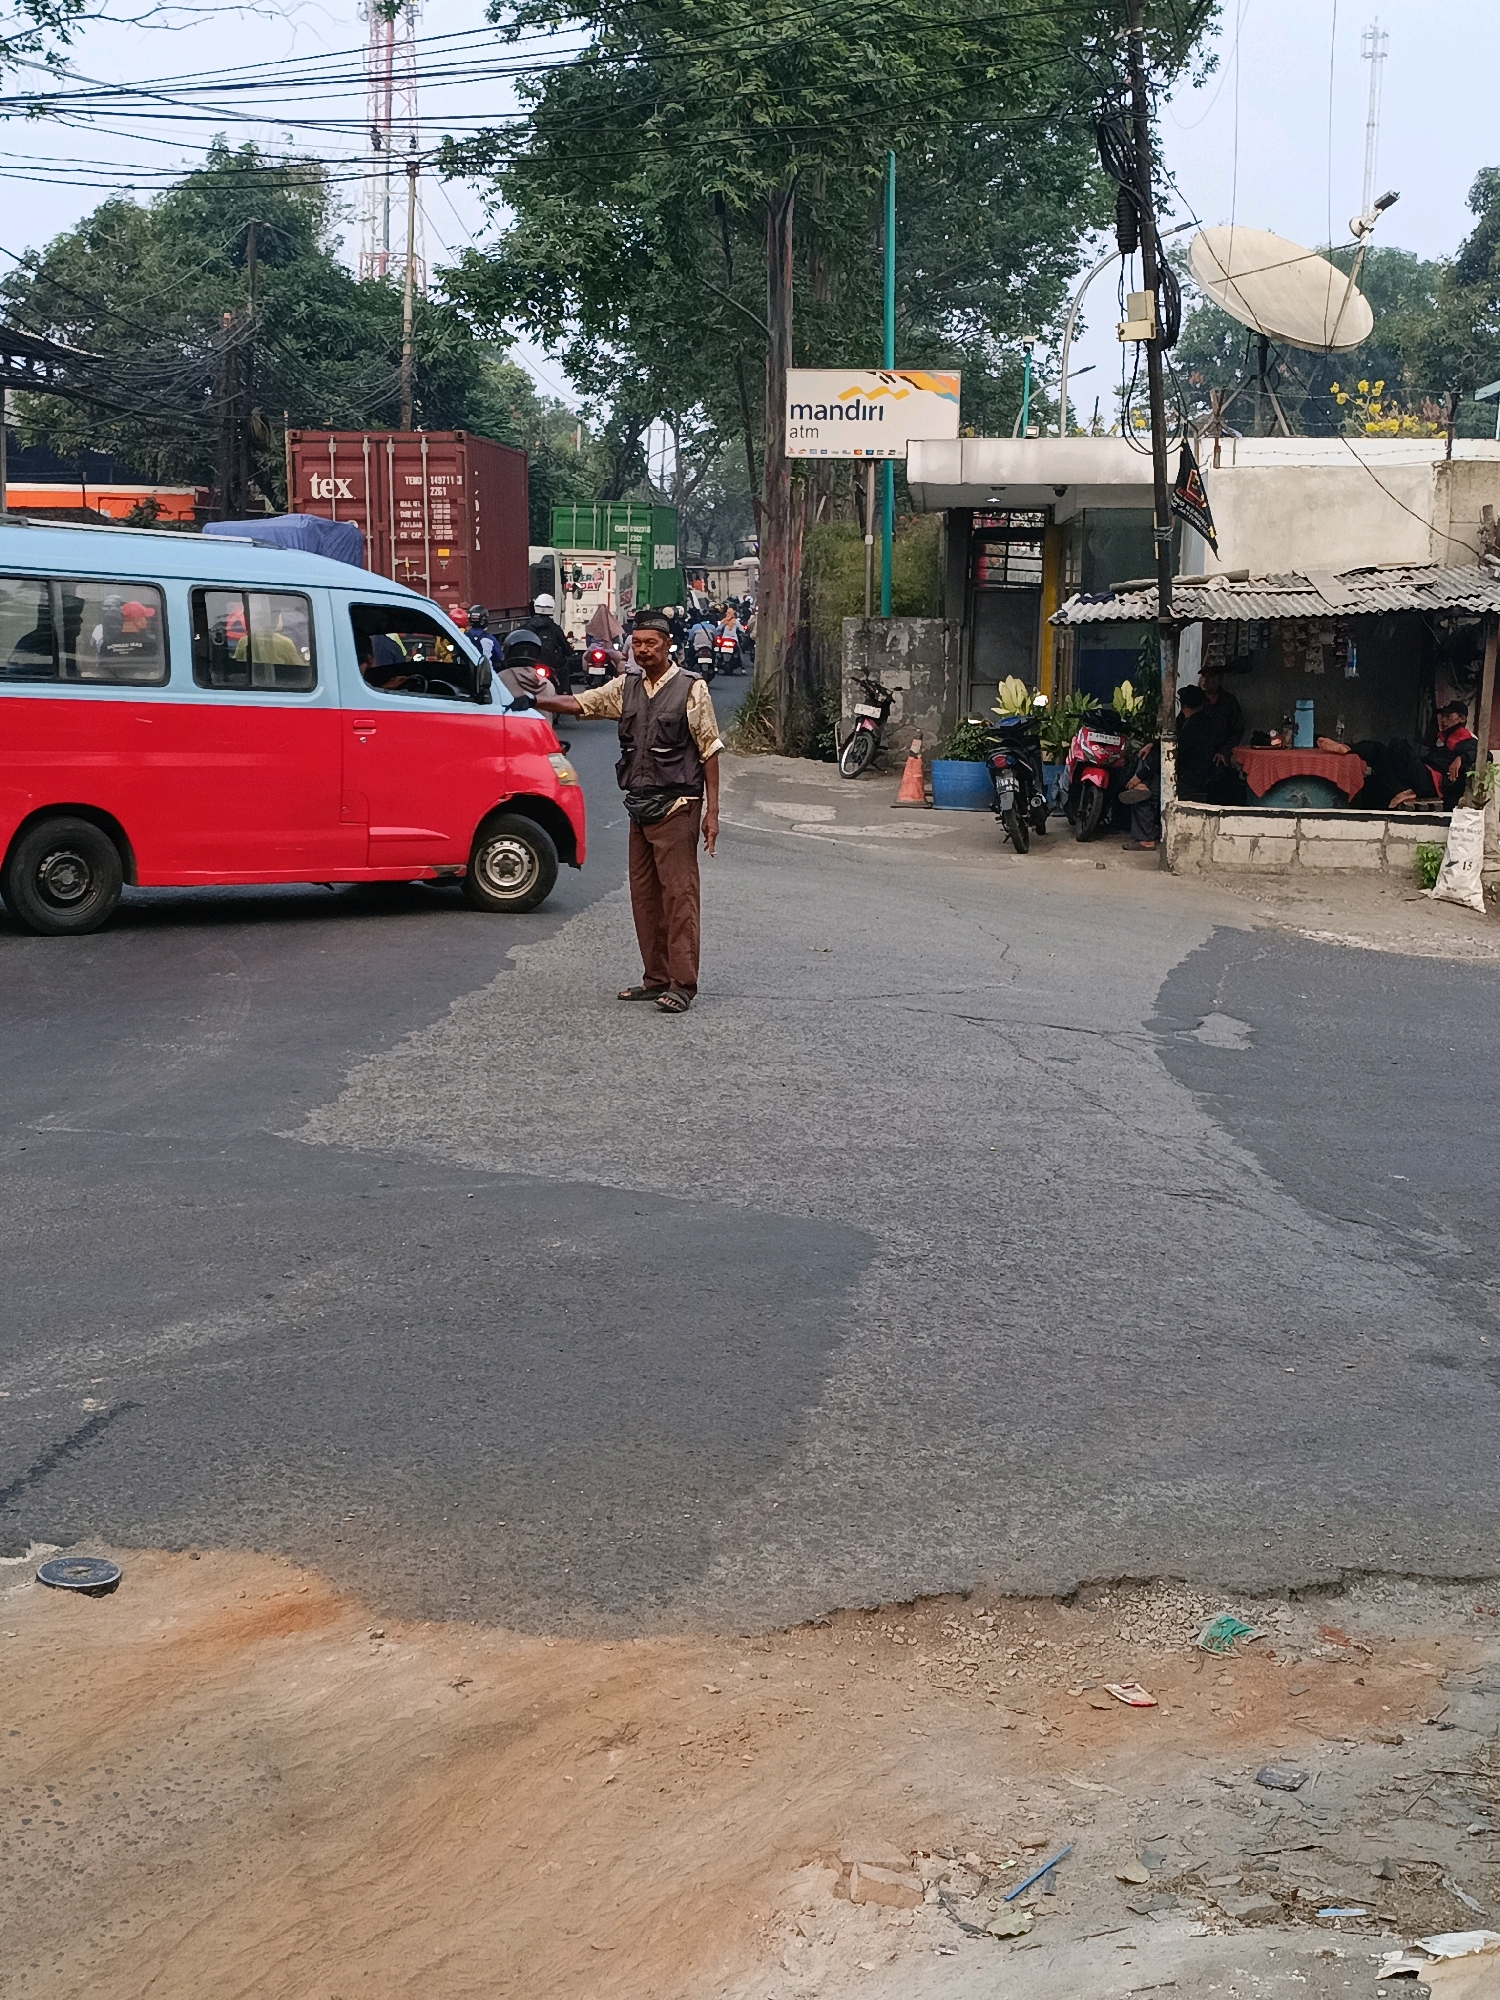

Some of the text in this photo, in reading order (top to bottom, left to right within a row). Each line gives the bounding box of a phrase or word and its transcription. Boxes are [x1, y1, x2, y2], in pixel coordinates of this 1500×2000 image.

[790, 399, 884, 421] mandiri
[789, 425, 819, 439] atm
[309, 472, 354, 500] tex
